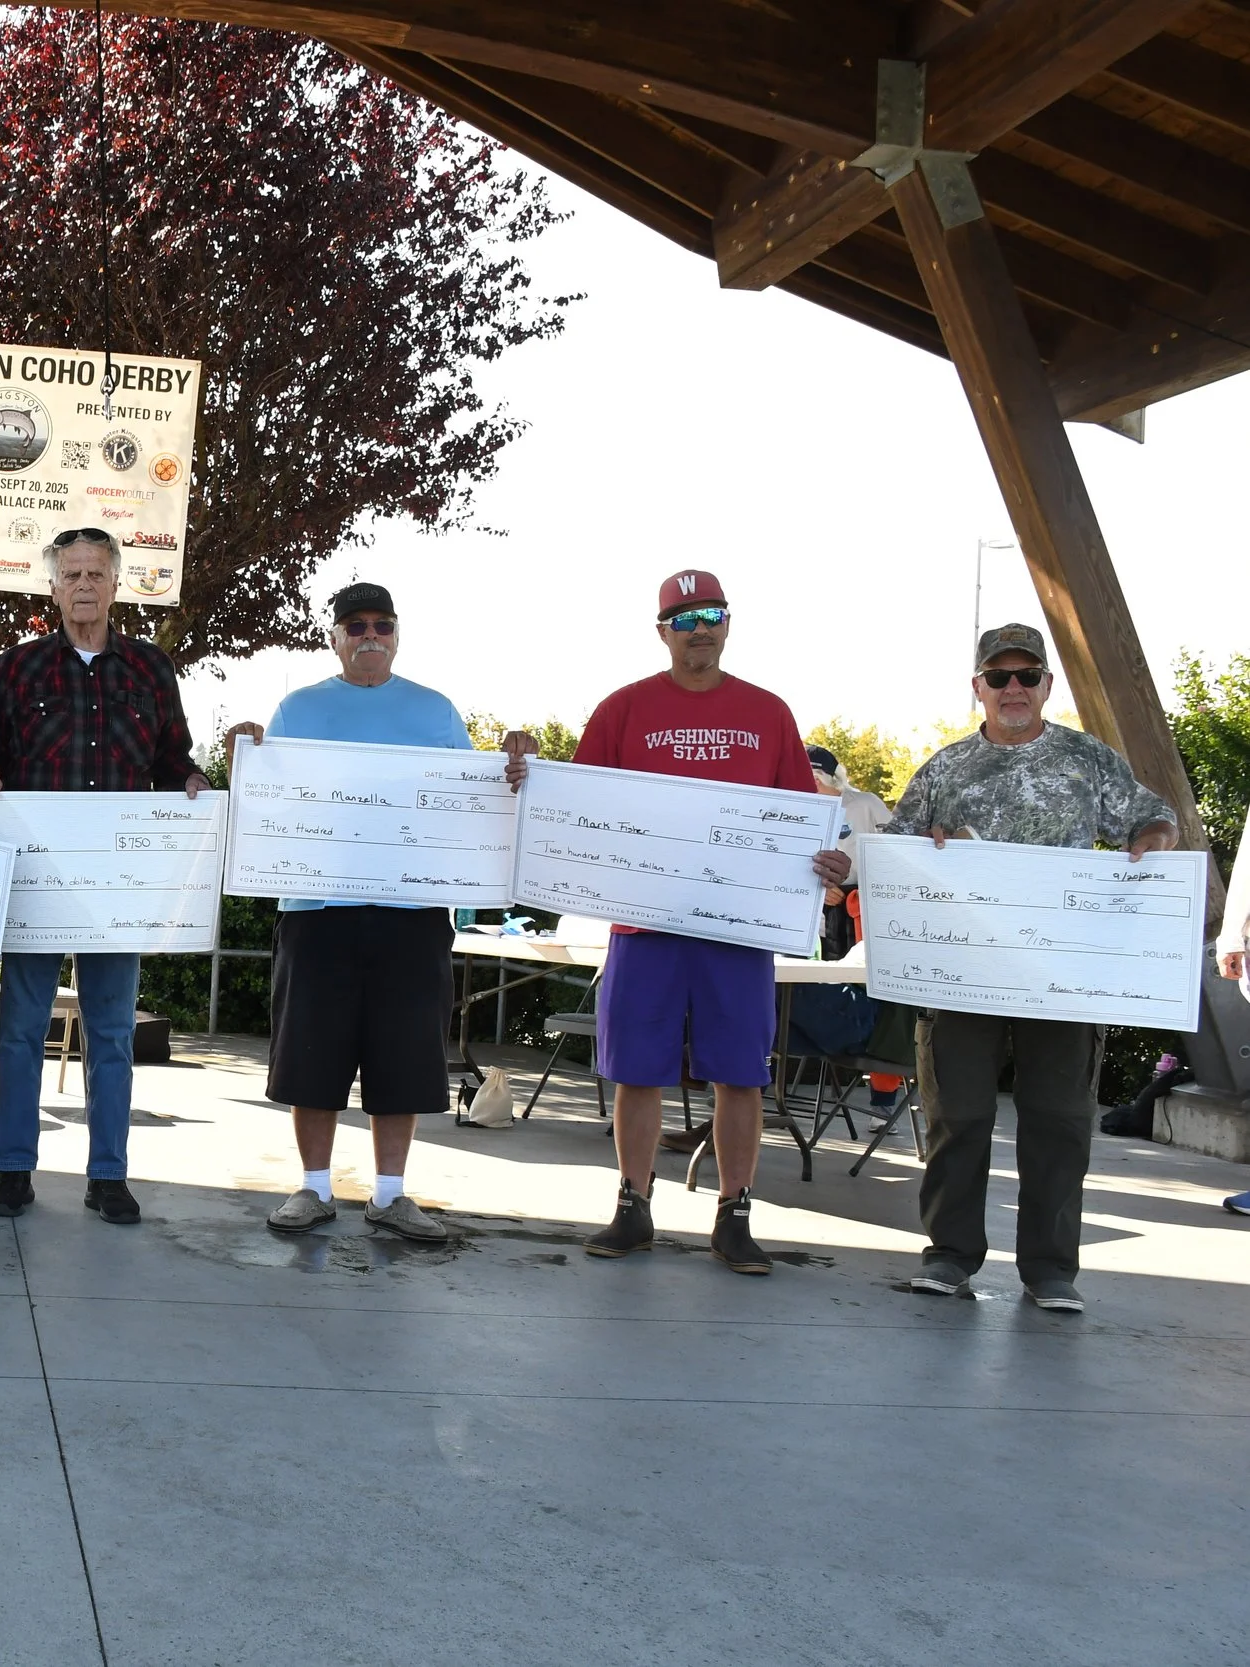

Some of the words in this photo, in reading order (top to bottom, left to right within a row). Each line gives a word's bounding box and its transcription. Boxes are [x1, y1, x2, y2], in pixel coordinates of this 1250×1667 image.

[21, 356, 95, 386] COHO
[155, 409, 172, 422] BY
[98, 429, 119, 448] Greater
[121, 428, 143, 452] Kingston
[0, 478, 26, 490] SEPT
[29, 481, 43, 493] 20,
[45, 482, 69, 494] 2025
[38, 499, 66, 512] PARK
[134, 531, 176, 546] Swift
[678, 575, 696, 595] W
[645, 728, 760, 750] WASHINGTON
[673, 745, 730, 760] STATE
[292, 786, 316, 798] Teo
[261, 820, 288, 833] Five
[296, 822, 333, 835] Hundred
[530, 814, 555, 822] ORDER
[578, 816, 610, 829] Mark
[534, 840, 562, 855] Two
[639, 860, 665, 872] dollars
[774, 886, 810, 895] DOLLARS
[12, 876, 38, 884] undred
[69, 876, 96, 886] dollars
[888, 920, 913, 937] One
[1143, 951, 1183, 960] DOLLARS
